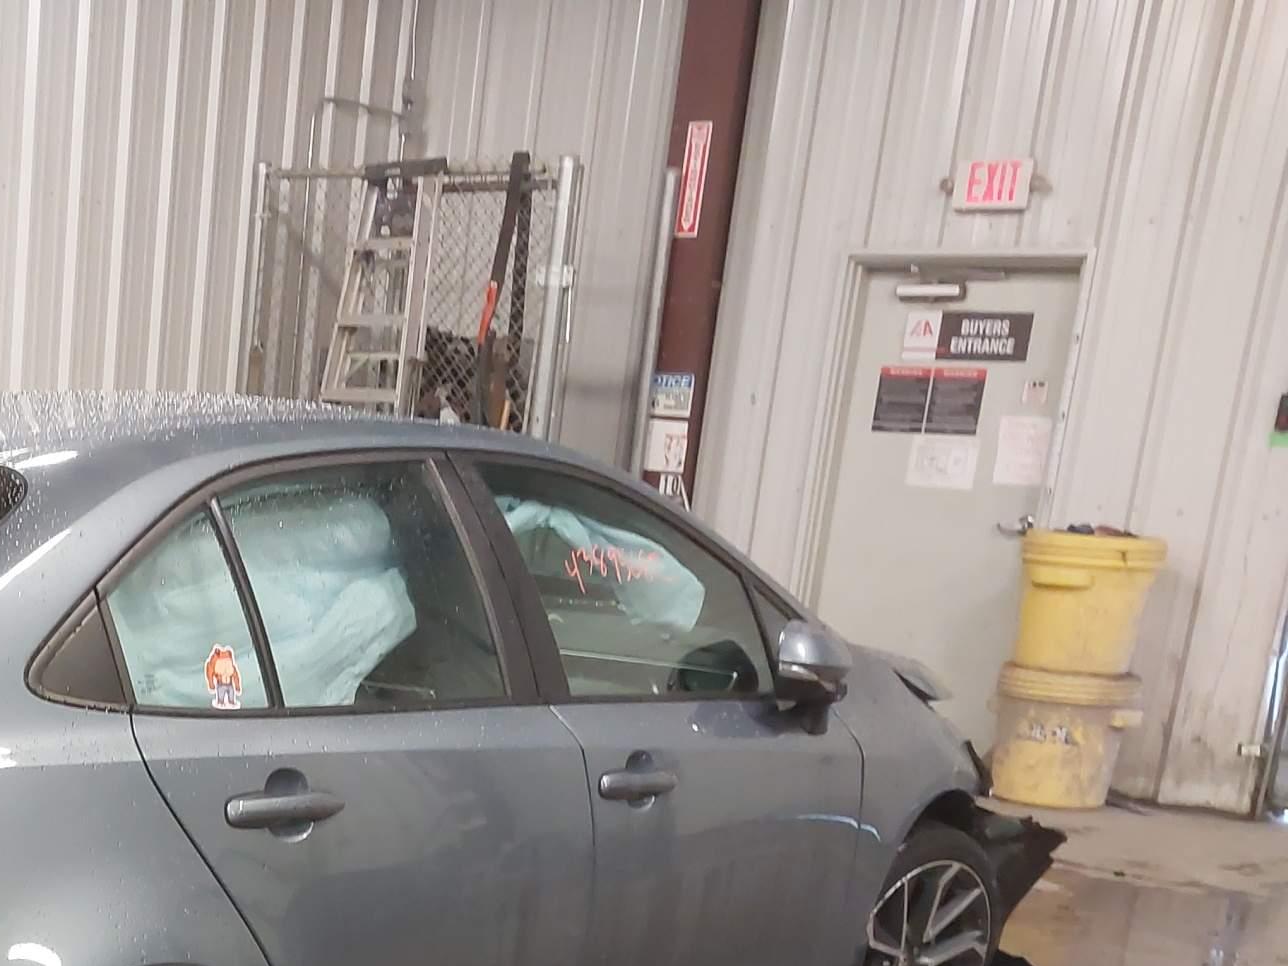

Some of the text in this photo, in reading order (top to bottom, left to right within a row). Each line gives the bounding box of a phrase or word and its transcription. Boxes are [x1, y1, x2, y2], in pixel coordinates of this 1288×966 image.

[966, 160, 1022, 203] EXIT
[960, 318, 1011, 337] BUYERS
[950, 335, 1016, 355] ENTRANCE
